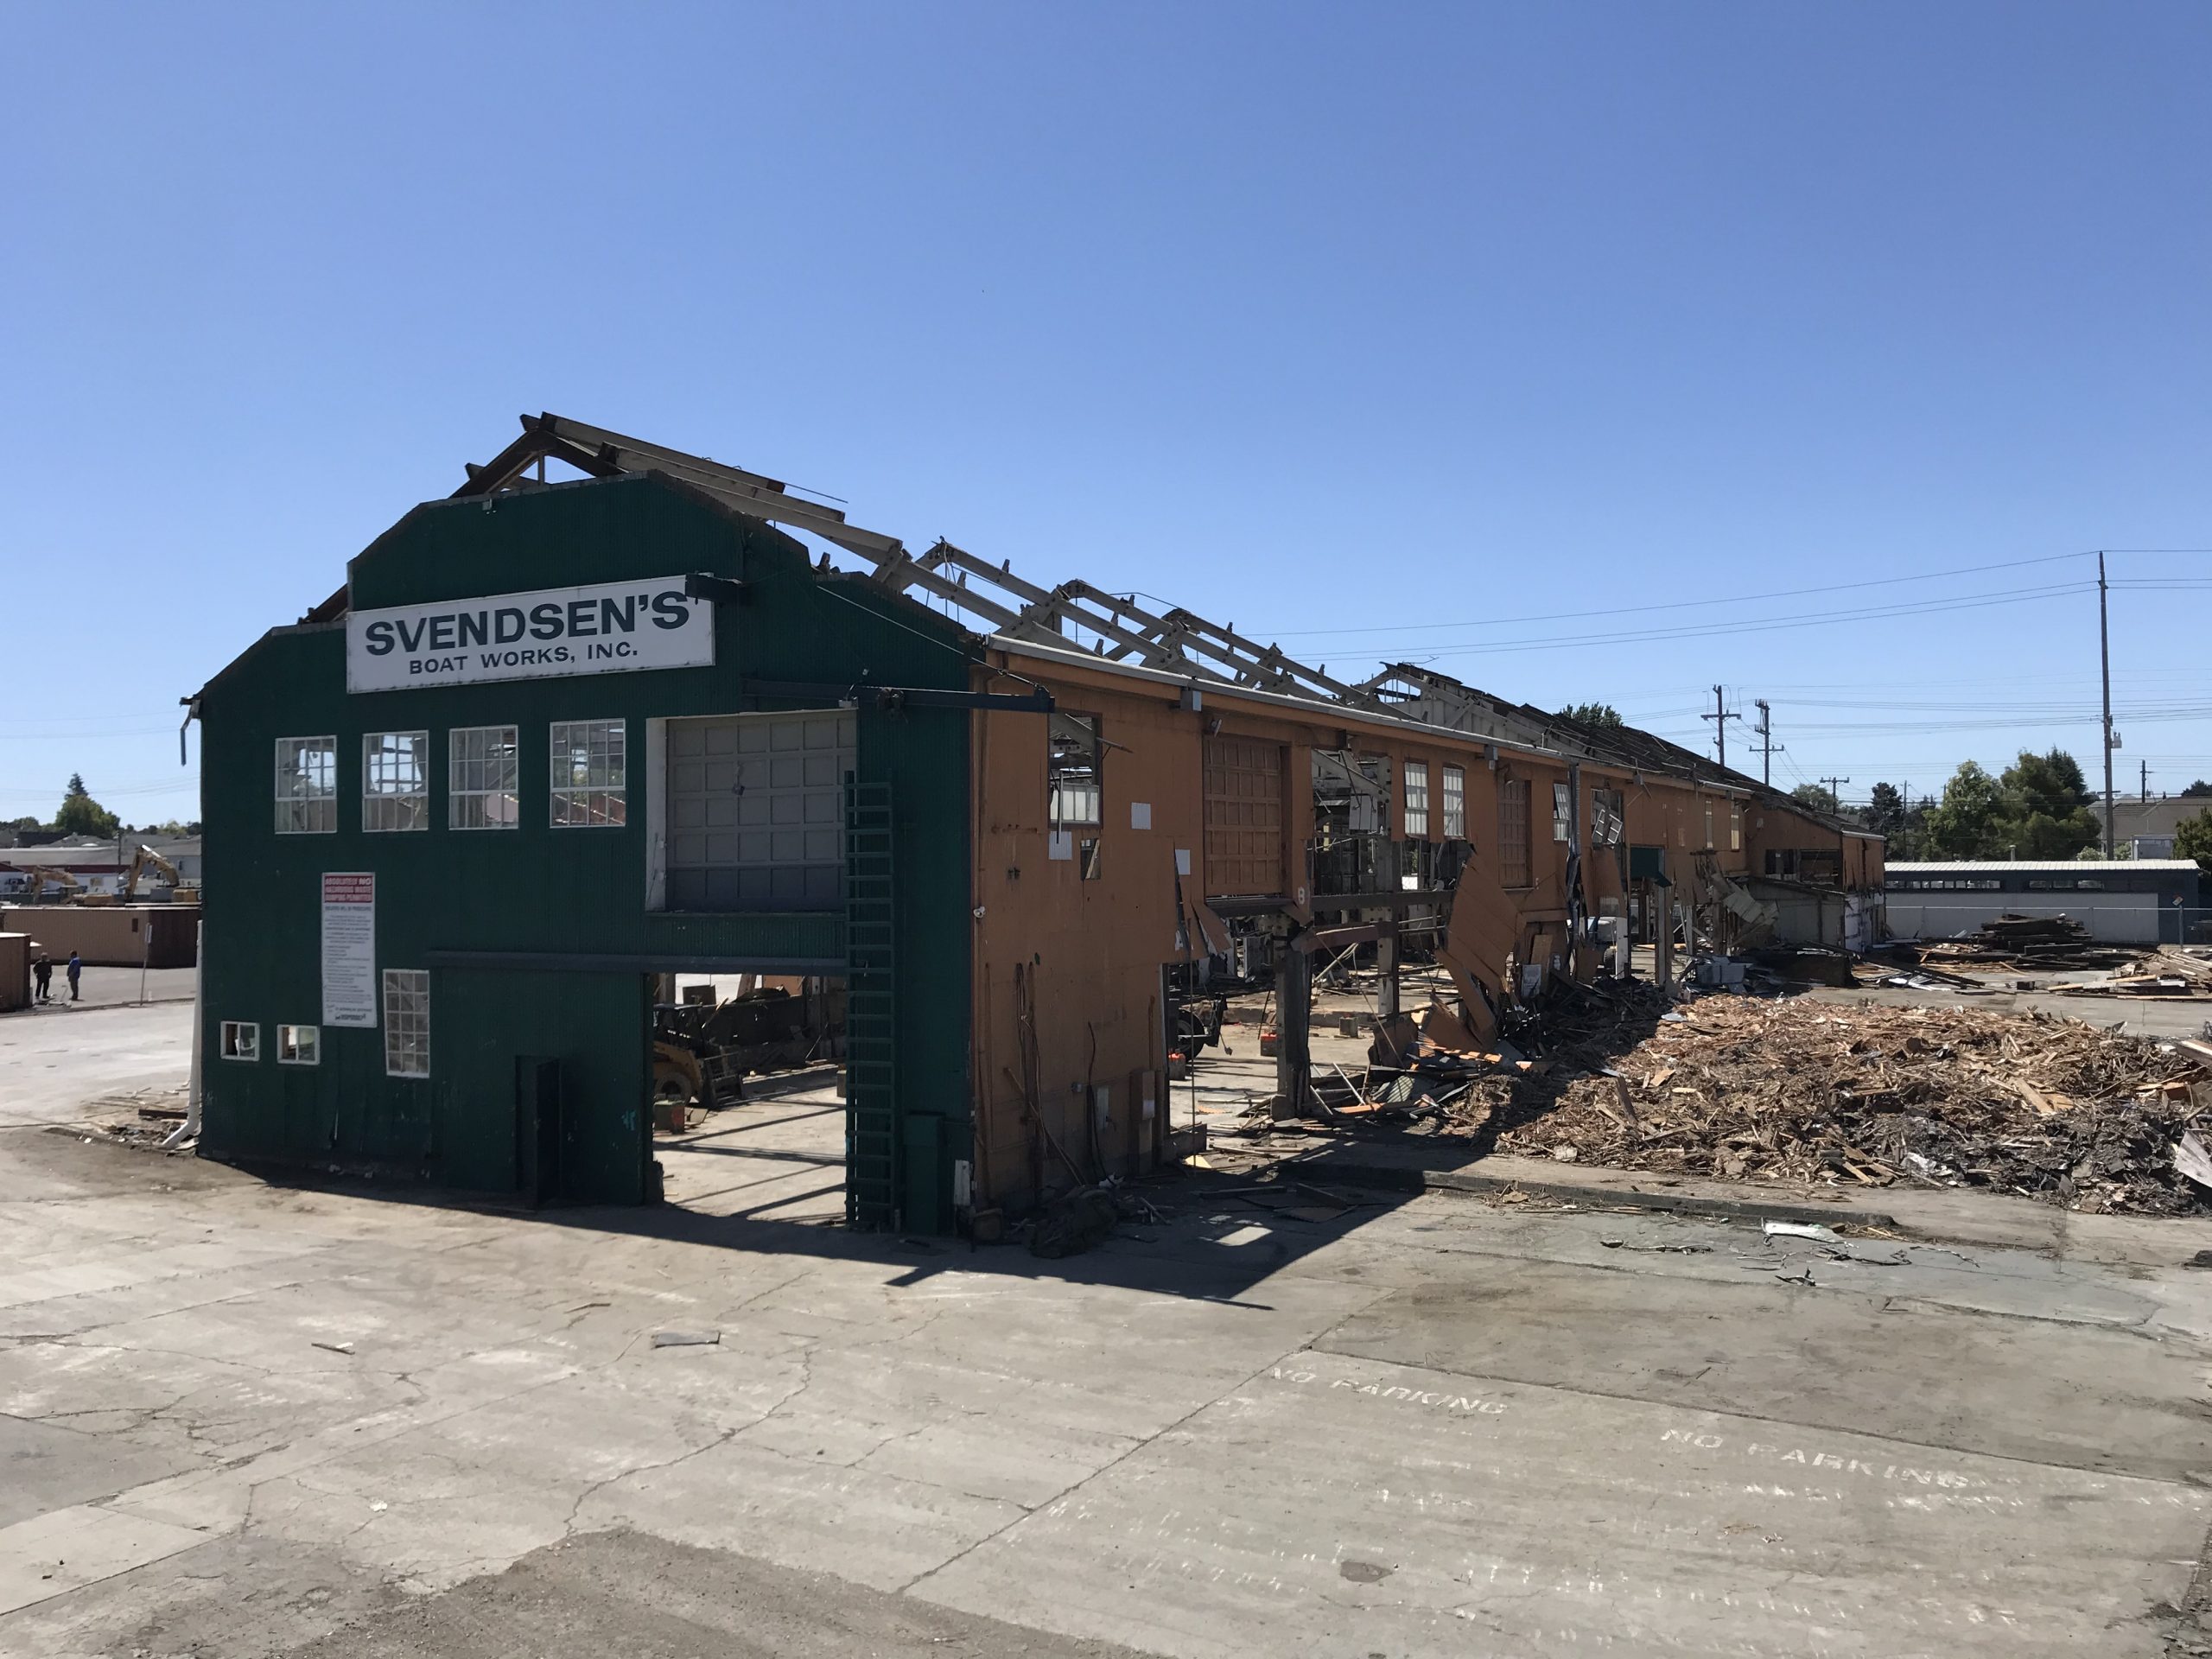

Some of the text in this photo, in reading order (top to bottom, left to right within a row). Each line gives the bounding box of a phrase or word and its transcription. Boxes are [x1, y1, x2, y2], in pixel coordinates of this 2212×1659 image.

[365, 591, 690, 656] SVENDSEN'S
[410, 641, 638, 675] BOAT WORKS, INC.
[359, 877, 372, 886] NO
[1330, 1378, 1508, 1414] PARKING
[1659, 1428, 1969, 1489] NO PARKING
